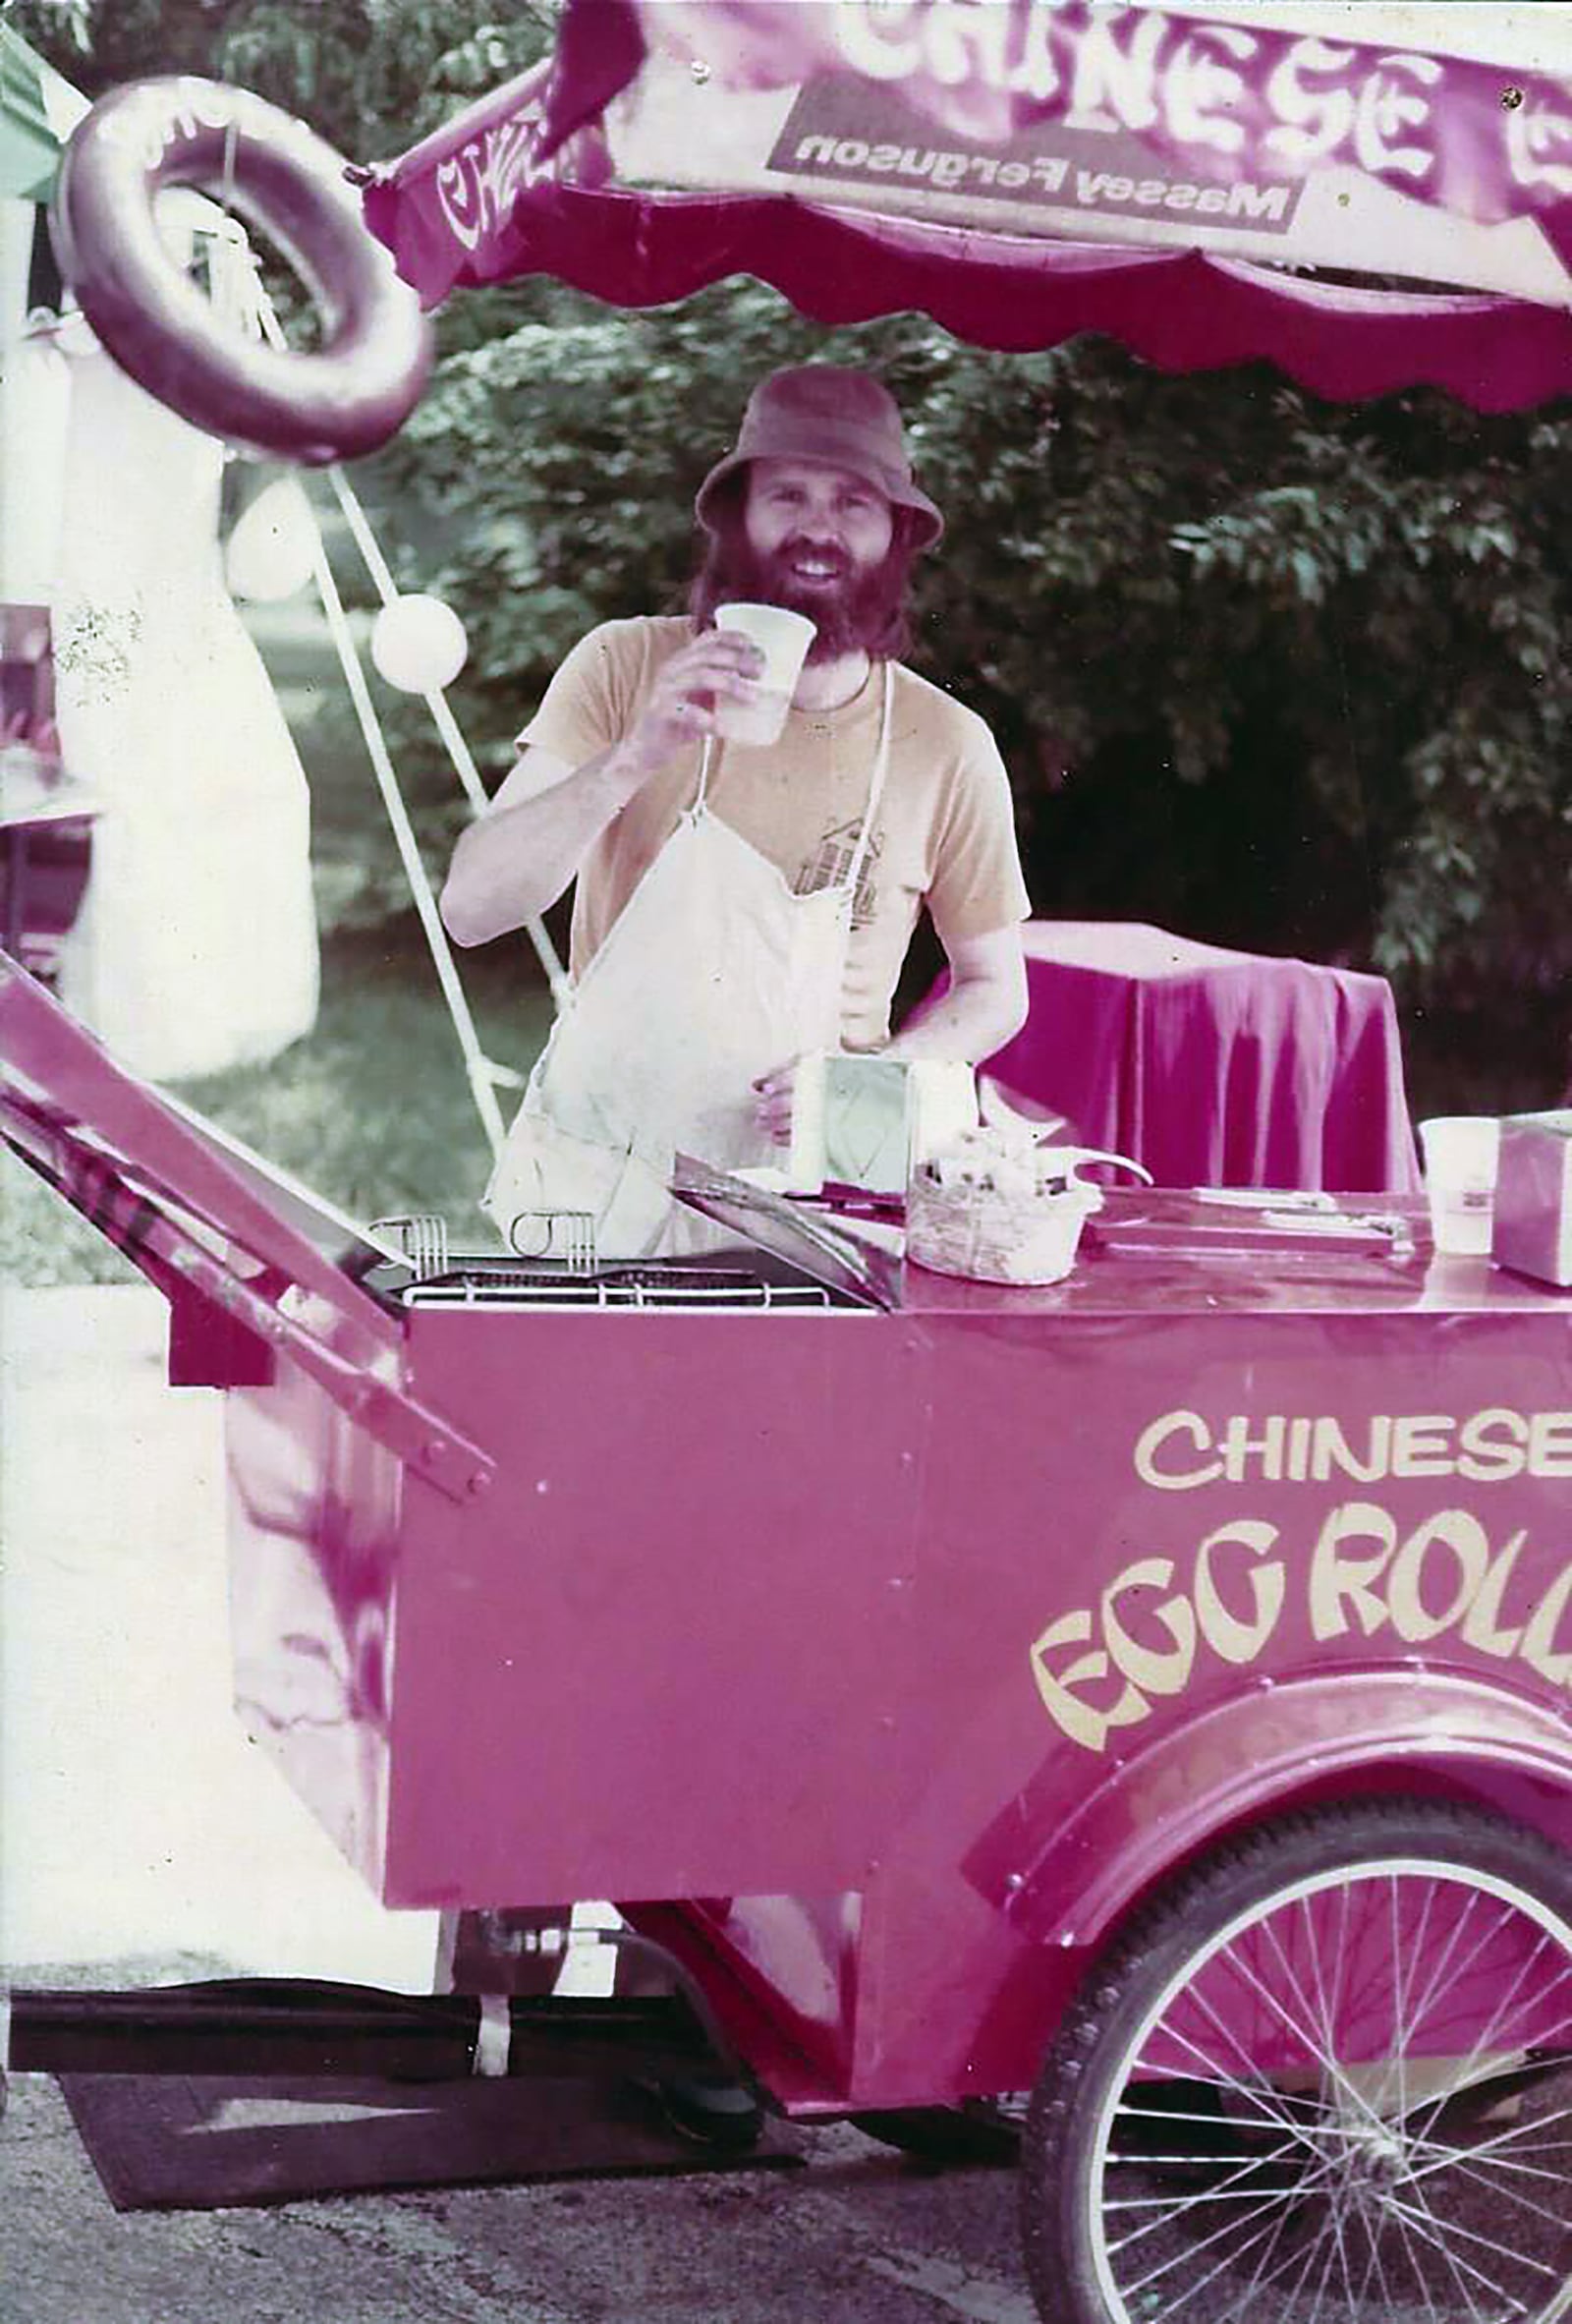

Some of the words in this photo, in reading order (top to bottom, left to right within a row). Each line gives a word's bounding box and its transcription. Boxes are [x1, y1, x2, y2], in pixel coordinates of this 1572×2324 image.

[833, 0, 1443, 177] CHINESE
[1134, 1408, 1572, 1490] CHINESE
[1030, 1519, 1285, 1752] EGG
